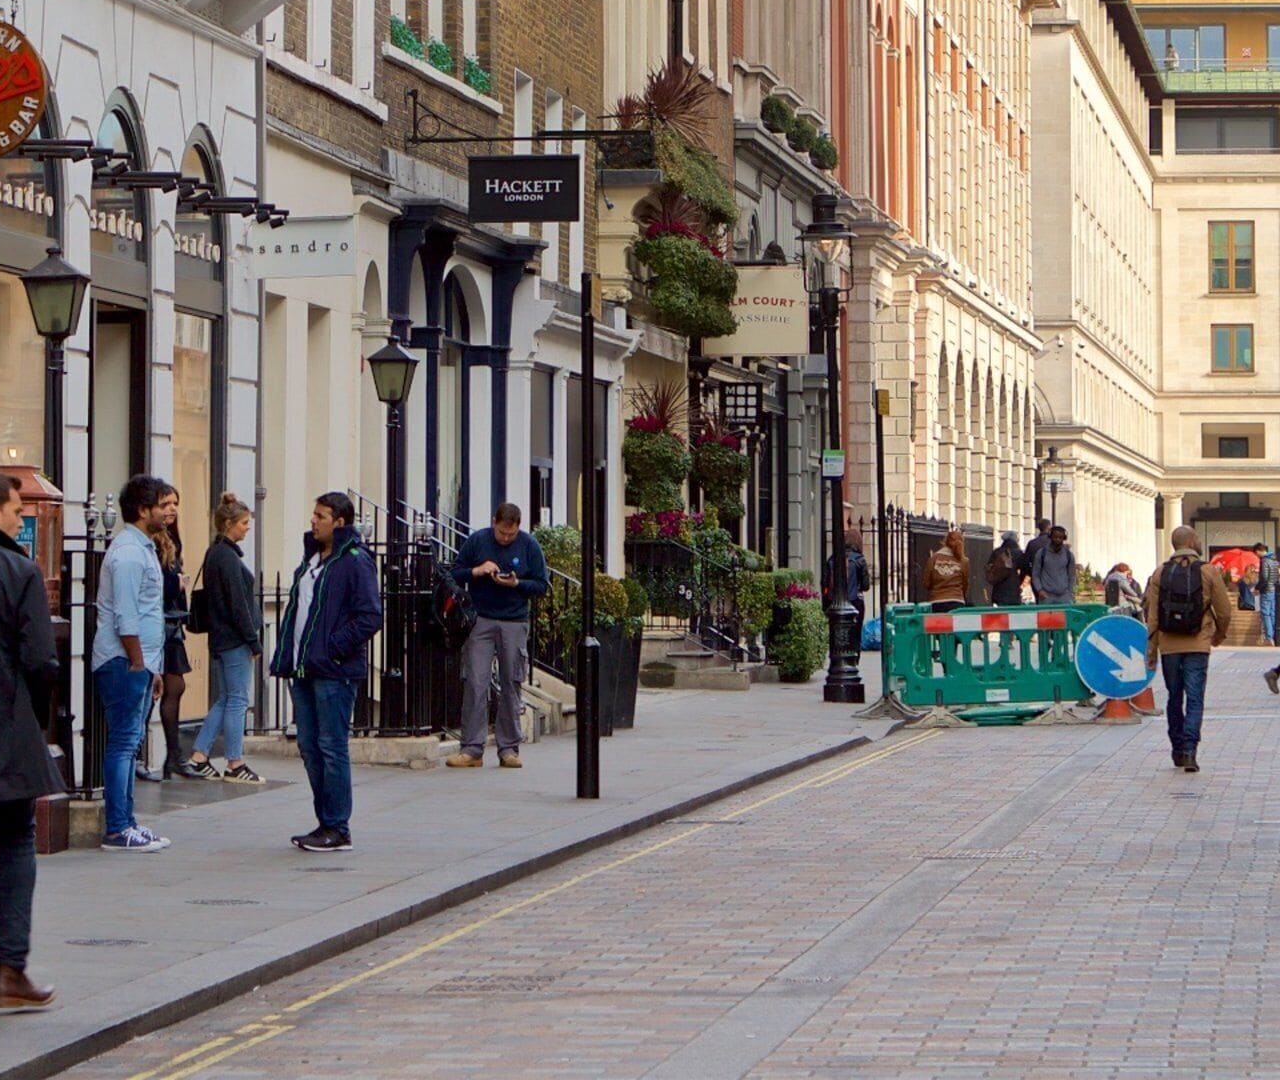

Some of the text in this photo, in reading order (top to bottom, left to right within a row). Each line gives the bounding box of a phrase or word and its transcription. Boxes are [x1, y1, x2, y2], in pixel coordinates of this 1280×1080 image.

[9, 95, 40, 135] BAR
[485, 178, 563, 194] HACKETT
[504, 194, 544, 202] LONDON
[89, 209, 143, 242] sandro
[174, 231, 221, 264] sandro
[259, 239, 349, 255] sandro
[753, 296, 795, 308] COURT
[738, 313, 791, 324] ASSERIE
[678, 584, 693, 600] 39
